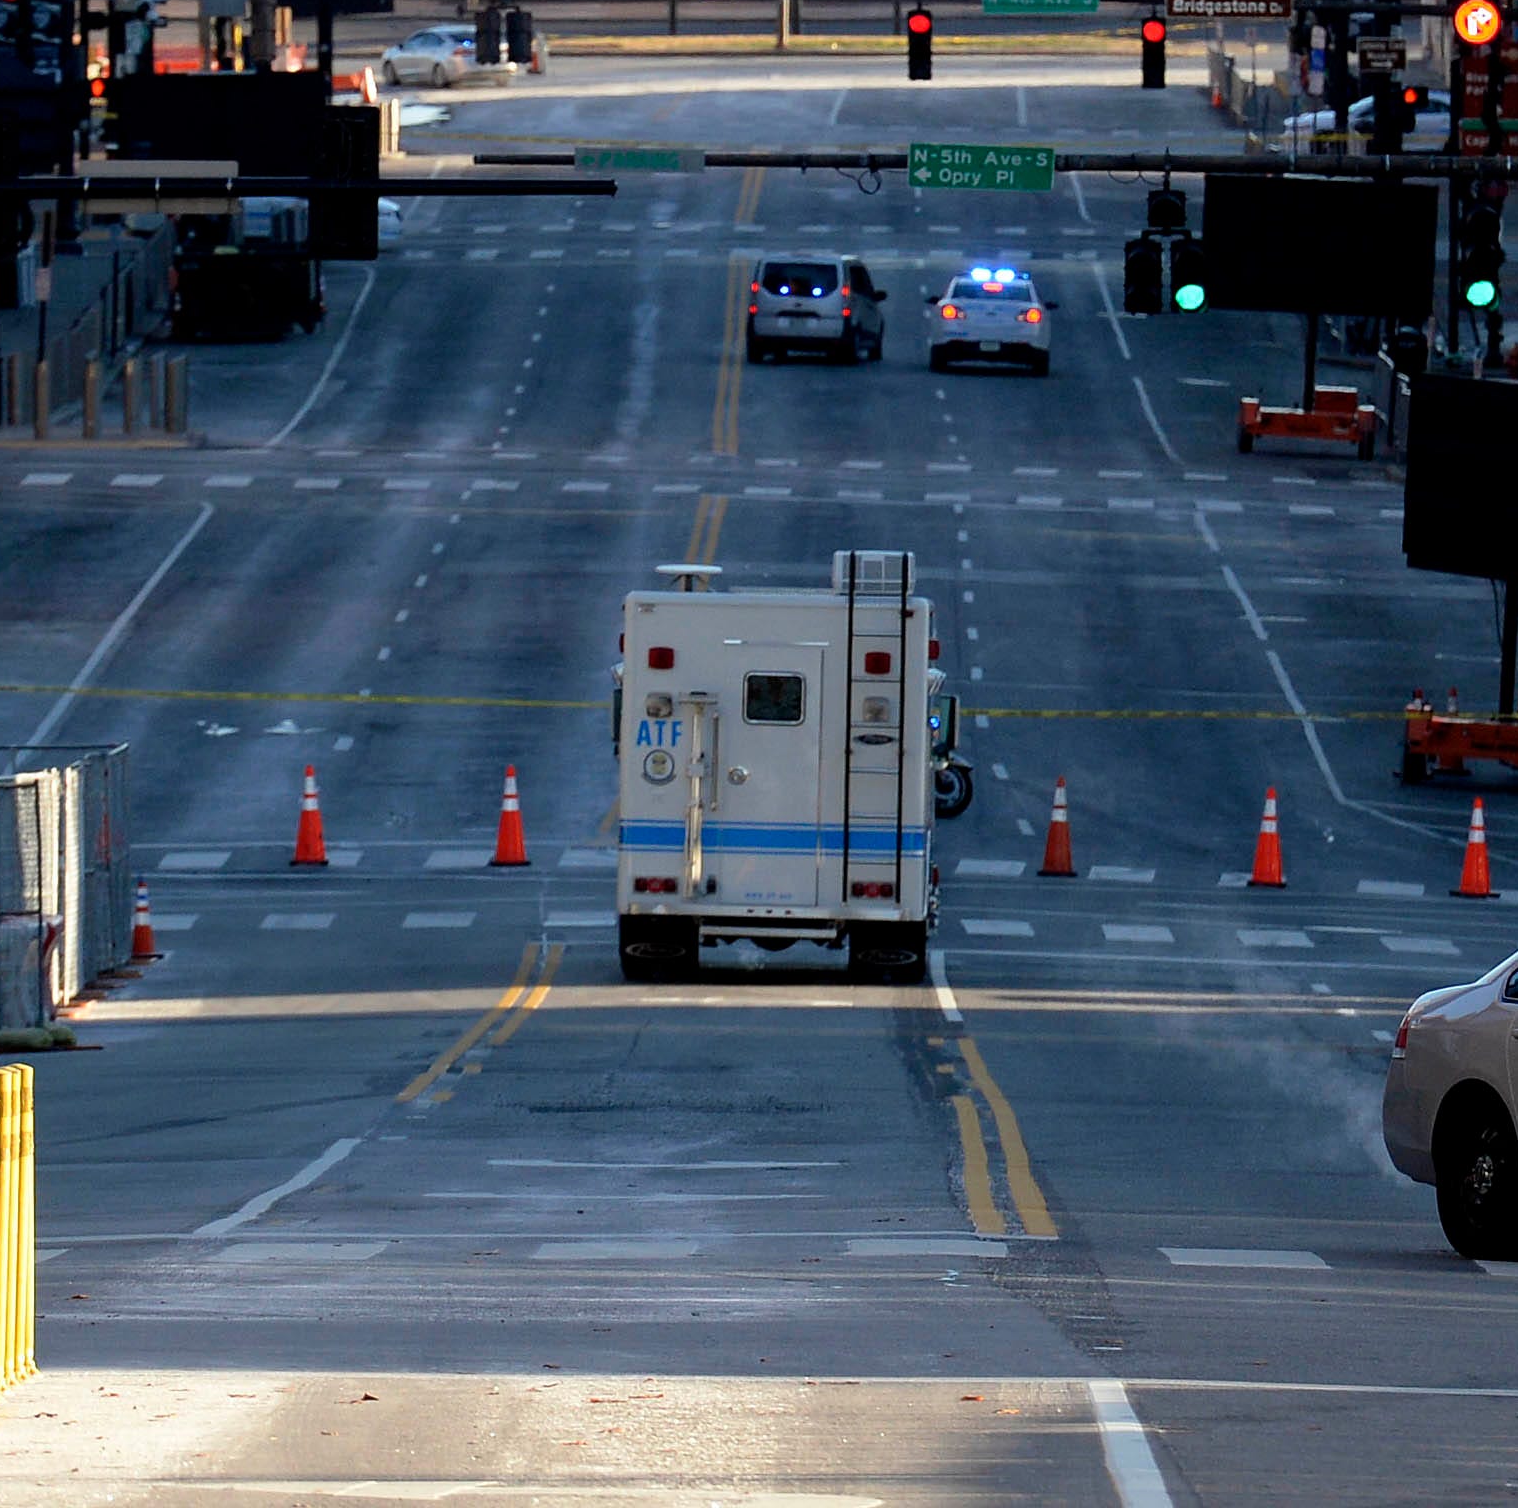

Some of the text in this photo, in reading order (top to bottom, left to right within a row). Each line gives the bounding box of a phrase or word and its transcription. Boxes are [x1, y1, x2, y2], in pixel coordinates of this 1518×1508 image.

[913, 148, 1049, 167] N-5th Ave-S
[938, 167, 982, 186] Opry
[636, 720, 684, 747] ATF
